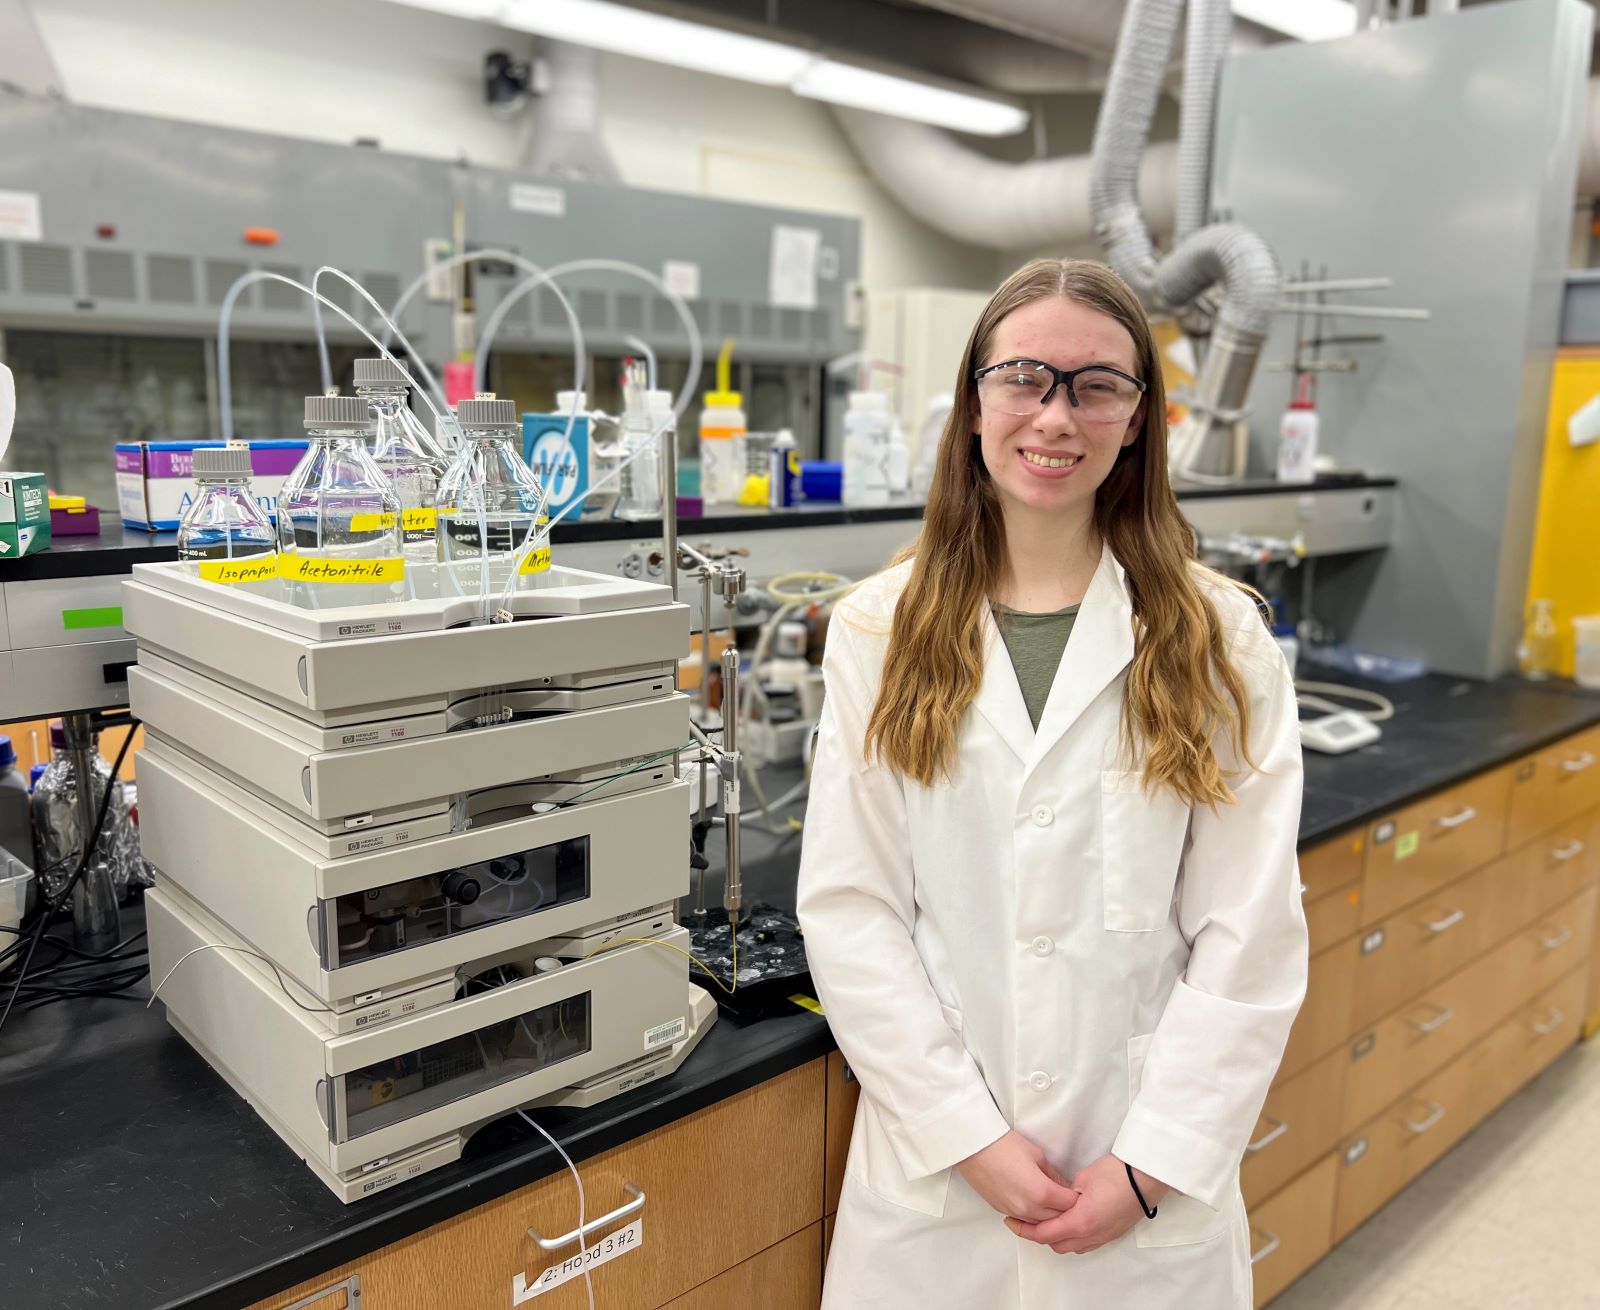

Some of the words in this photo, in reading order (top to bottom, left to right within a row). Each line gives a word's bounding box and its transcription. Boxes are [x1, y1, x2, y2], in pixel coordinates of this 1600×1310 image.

[4, 481, 10, 493] 1
[300, 560, 384, 577] Acetonitrile
[605, 1239, 614, 1253] 3
[617, 1228, 635, 1248] #2
